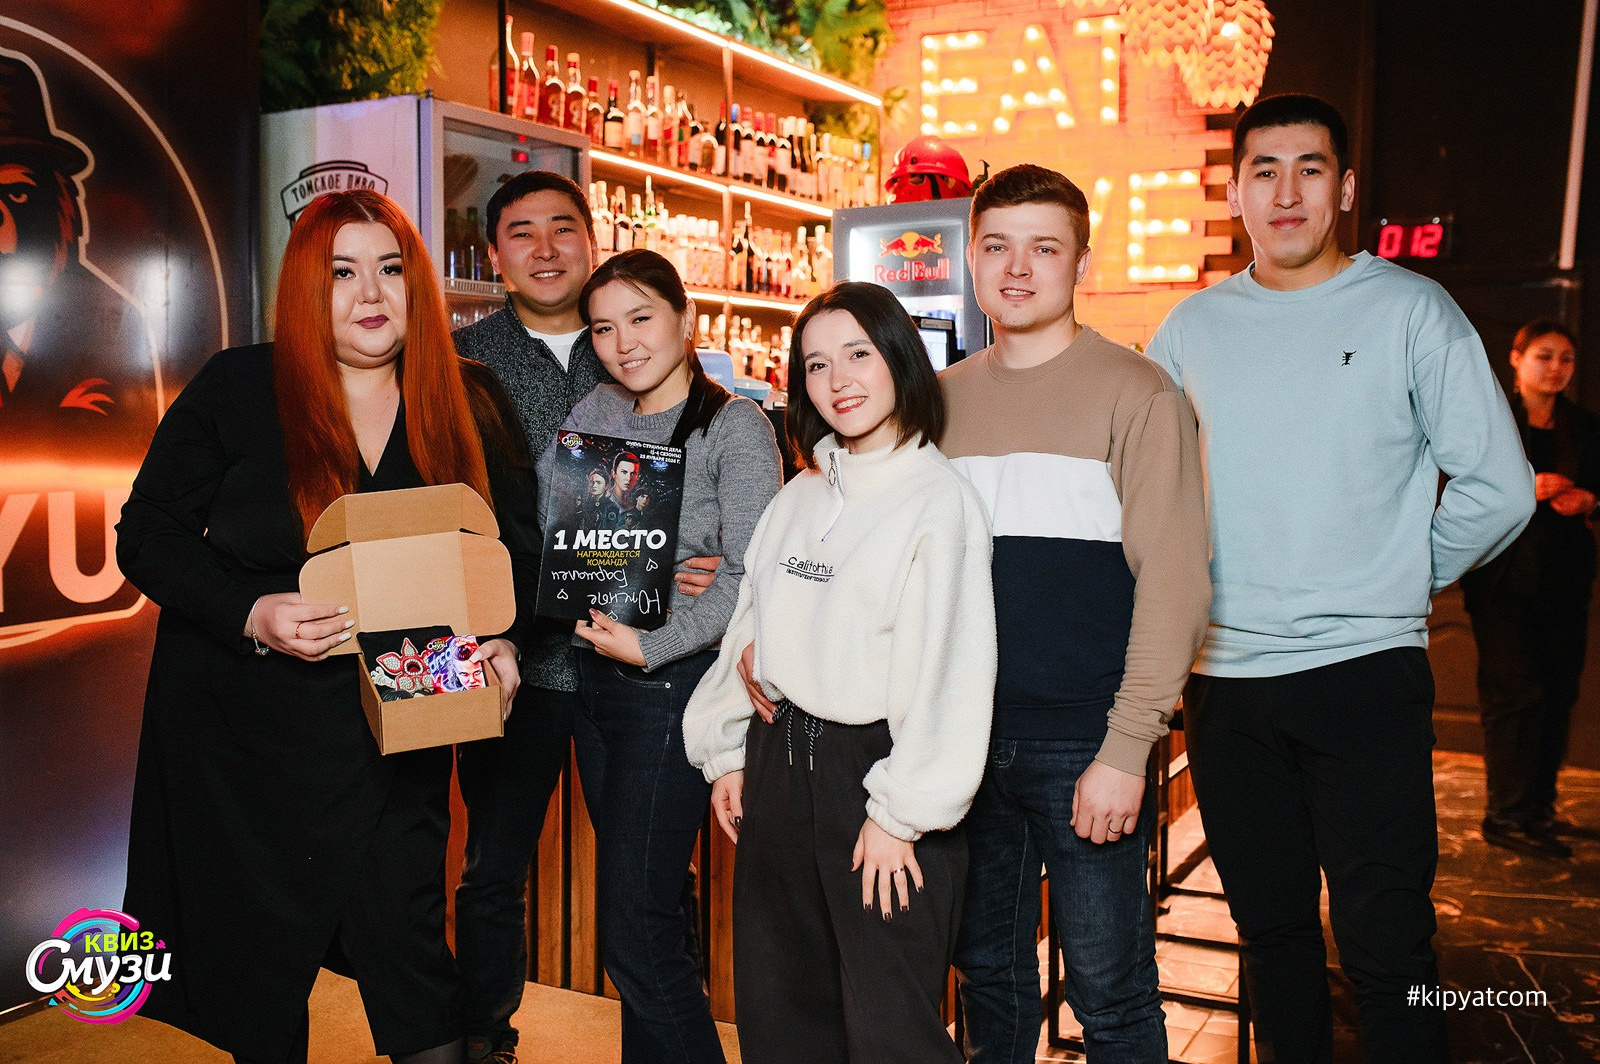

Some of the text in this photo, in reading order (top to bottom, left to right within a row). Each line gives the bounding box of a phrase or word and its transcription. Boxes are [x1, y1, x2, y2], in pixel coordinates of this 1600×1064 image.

[920, 14, 1127, 137] EAT
[291, 174, 342, 202] ТОМСКОЕ
[874, 258, 950, 283] Red Bull
[553, 529, 667, 550] 1 МЕСТО
[576, 550, 641, 558] НАГРАЖДАЕТСЯ
[586, 558, 629, 567] КОМАНДА
